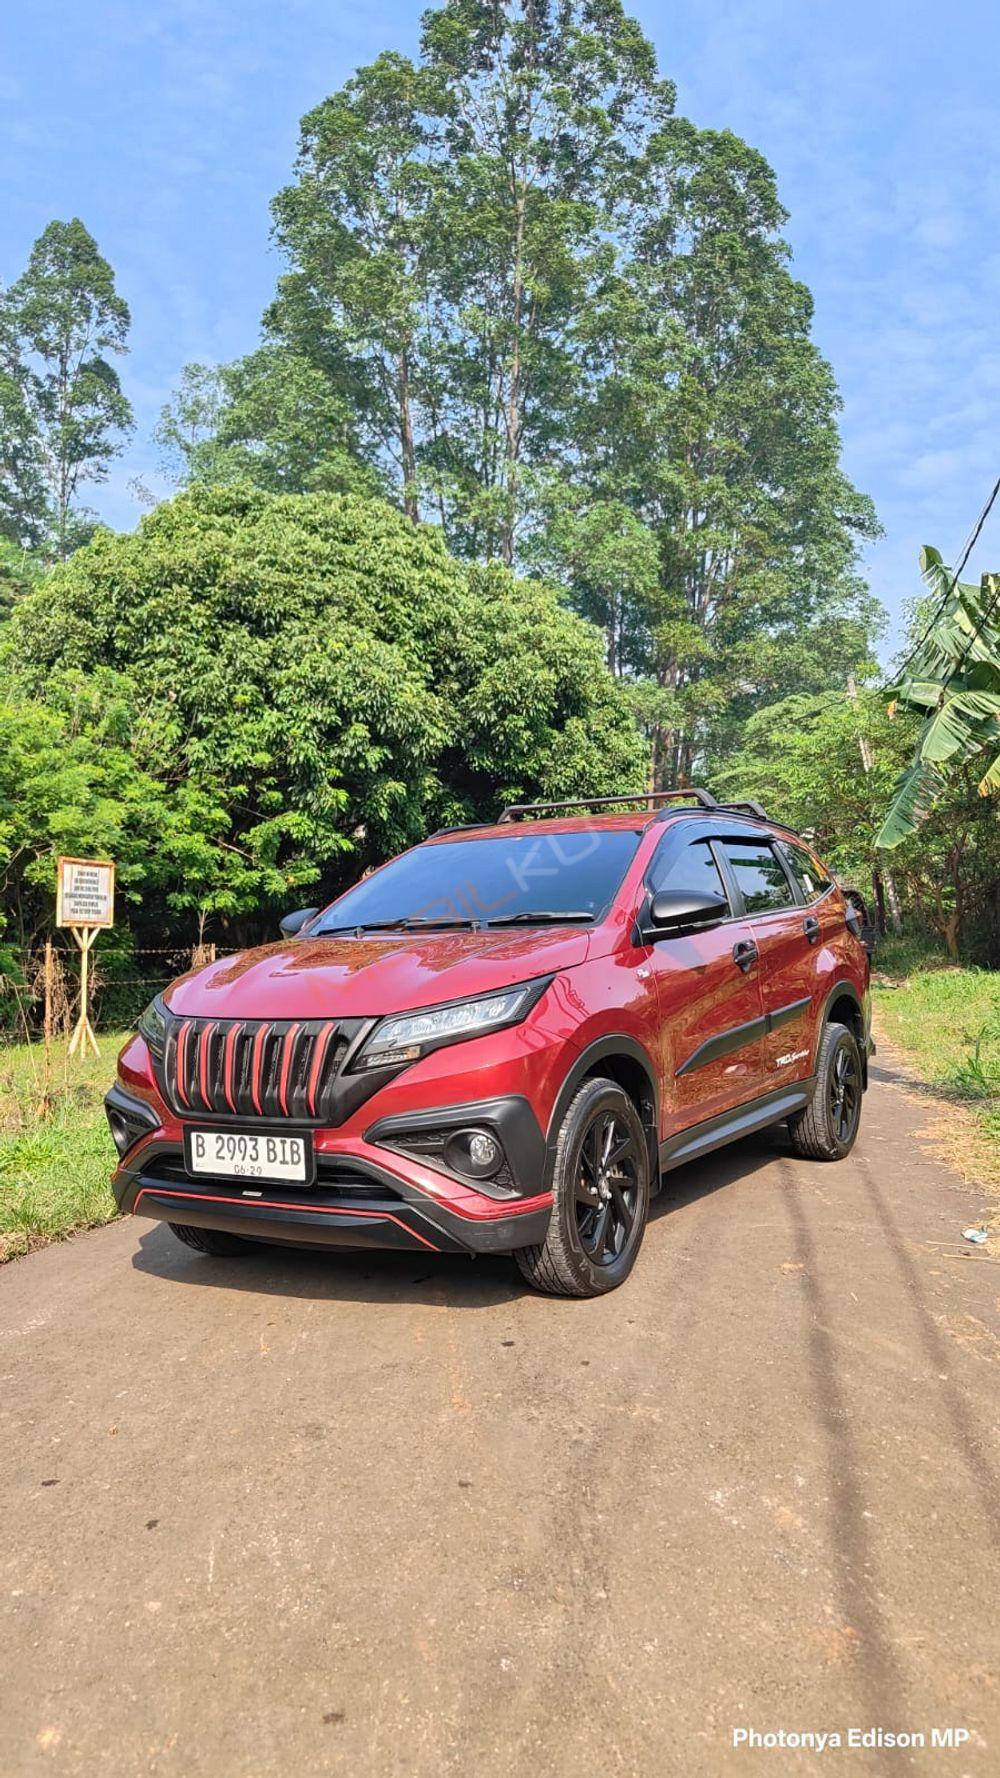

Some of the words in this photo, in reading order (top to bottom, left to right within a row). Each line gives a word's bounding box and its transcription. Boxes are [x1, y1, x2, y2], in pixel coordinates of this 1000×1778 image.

[195, 1133, 206, 1158] B
[215, 1135, 259, 1162] 2993
[266, 1138, 301, 1165] BIB
